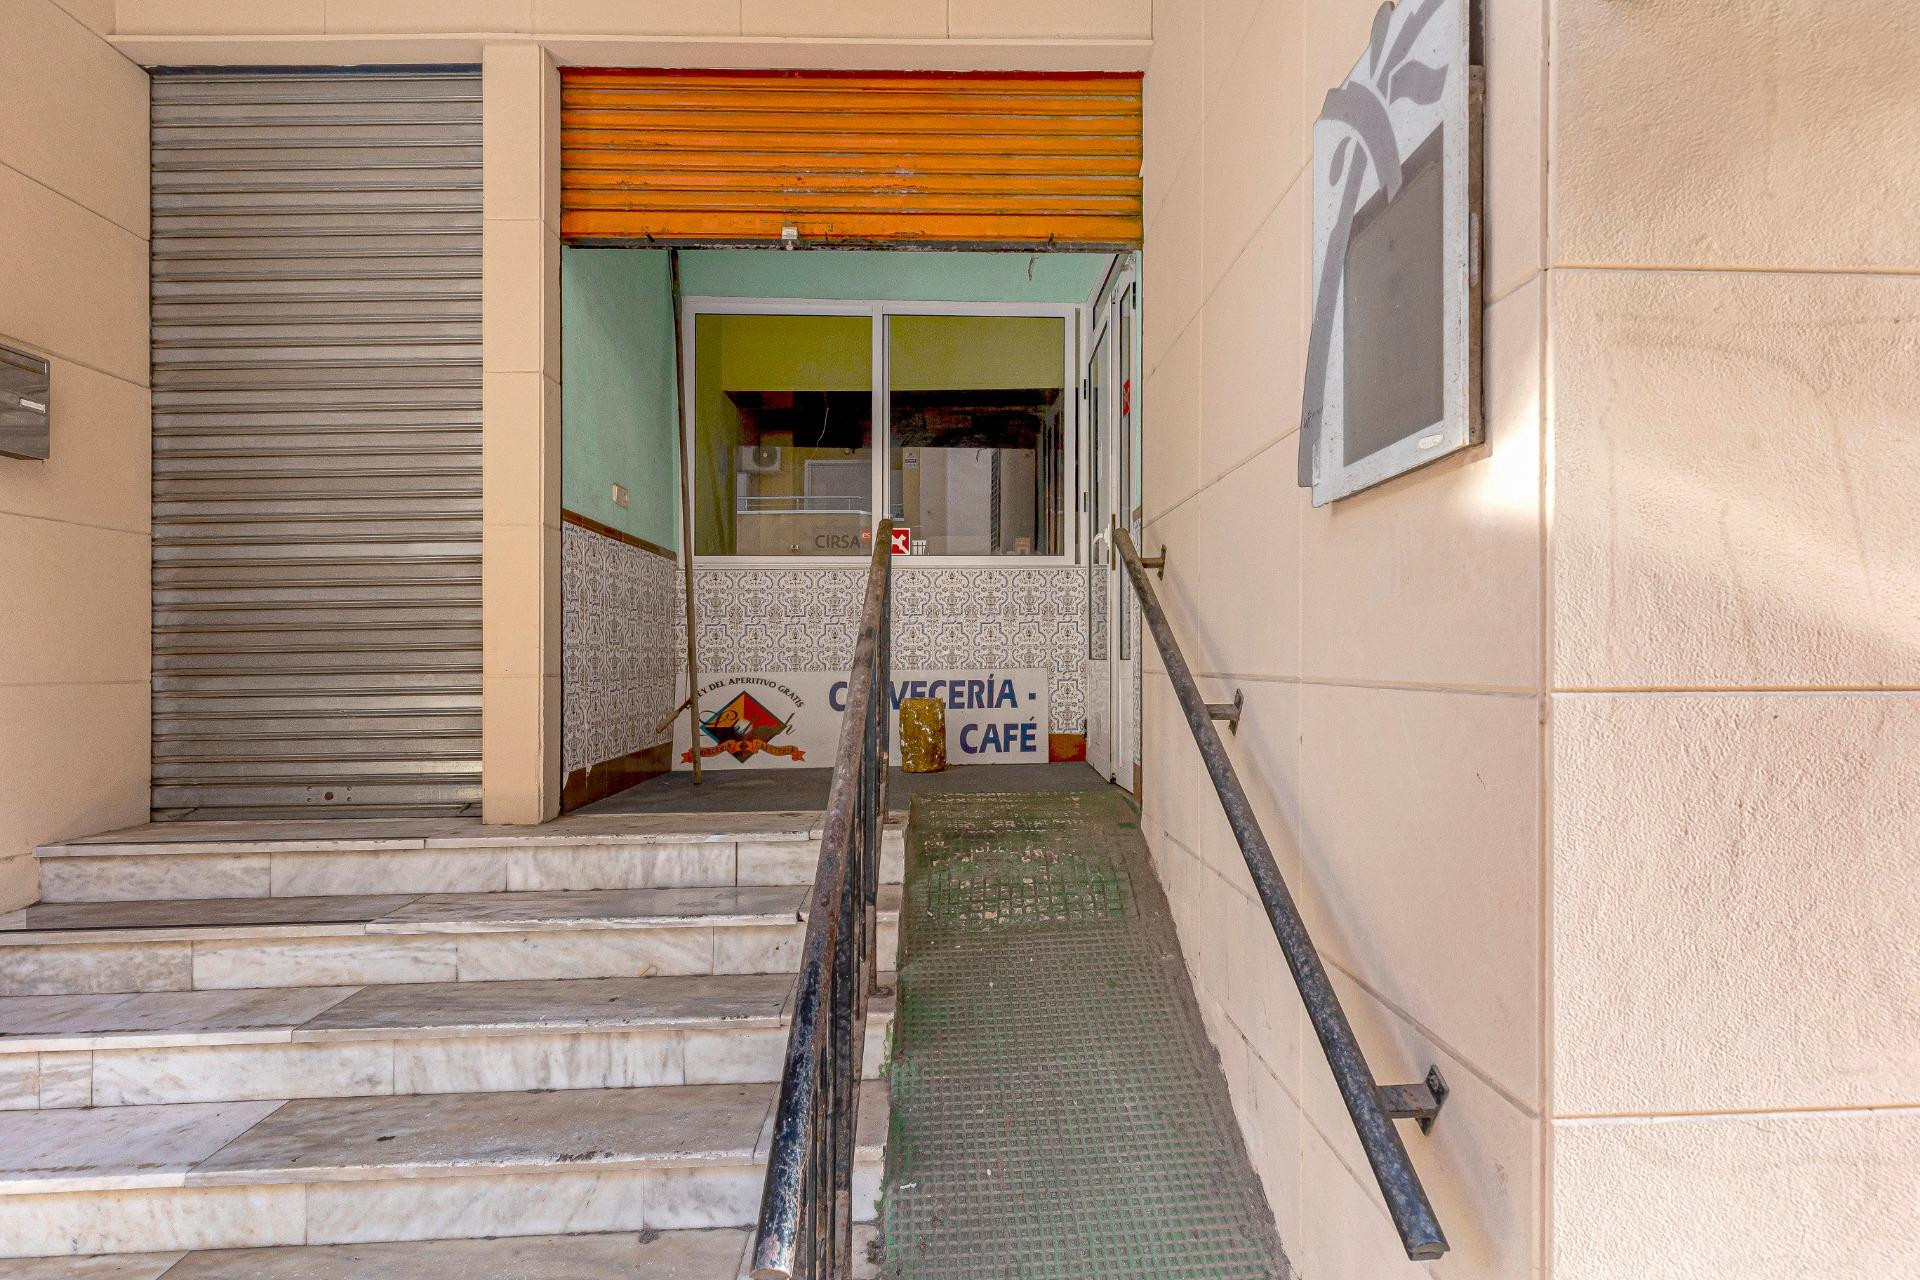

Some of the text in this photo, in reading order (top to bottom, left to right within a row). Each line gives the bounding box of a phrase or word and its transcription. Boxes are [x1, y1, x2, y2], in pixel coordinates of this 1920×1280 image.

[815, 535, 861, 549] CIRSA
[709, 681, 726, 691] DEL
[728, 677, 777, 689] APERITIVO
[778, 684, 805, 708] GRATIS
[829, 674, 1018, 711] CVECERÍA
[960, 716, 1037, 754] CAFÉ
